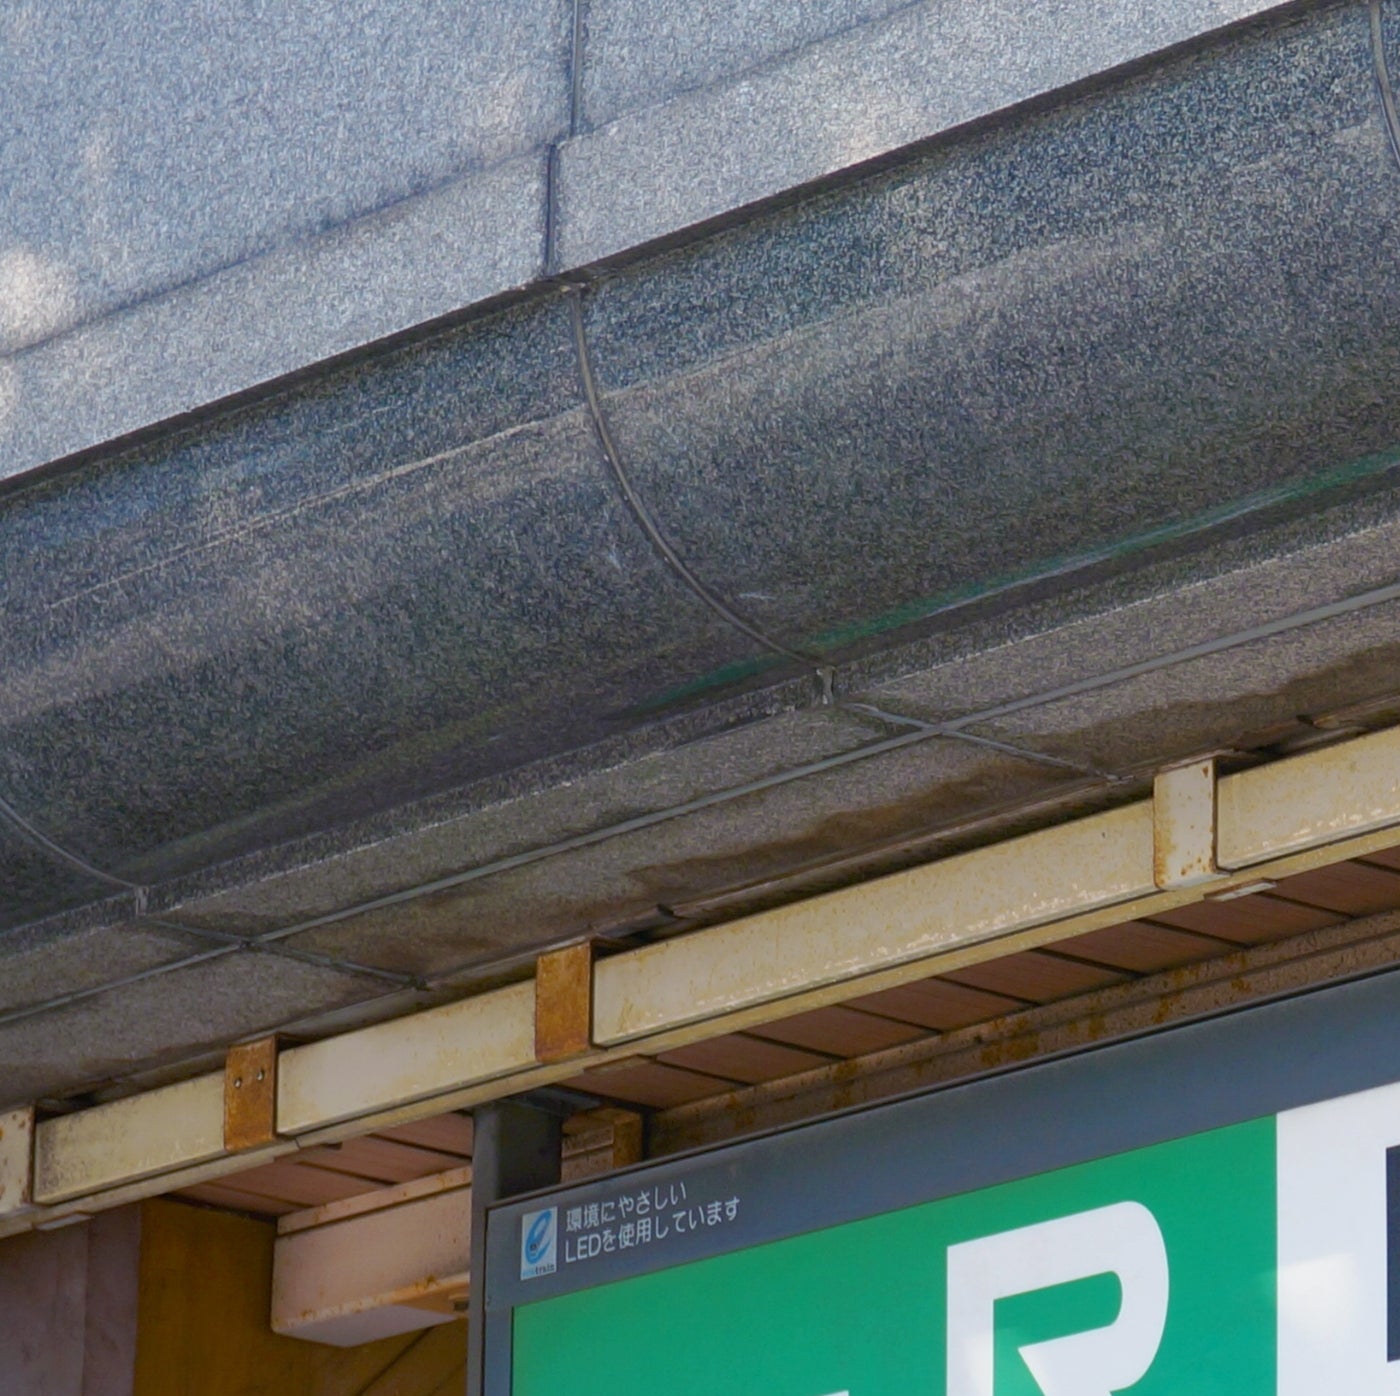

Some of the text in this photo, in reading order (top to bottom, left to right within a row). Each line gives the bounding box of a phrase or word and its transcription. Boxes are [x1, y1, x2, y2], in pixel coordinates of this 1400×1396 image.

[564, 1195, 741, 1264] LEDを使用しています
[565, 1181, 687, 1232] 環境にやさしい
